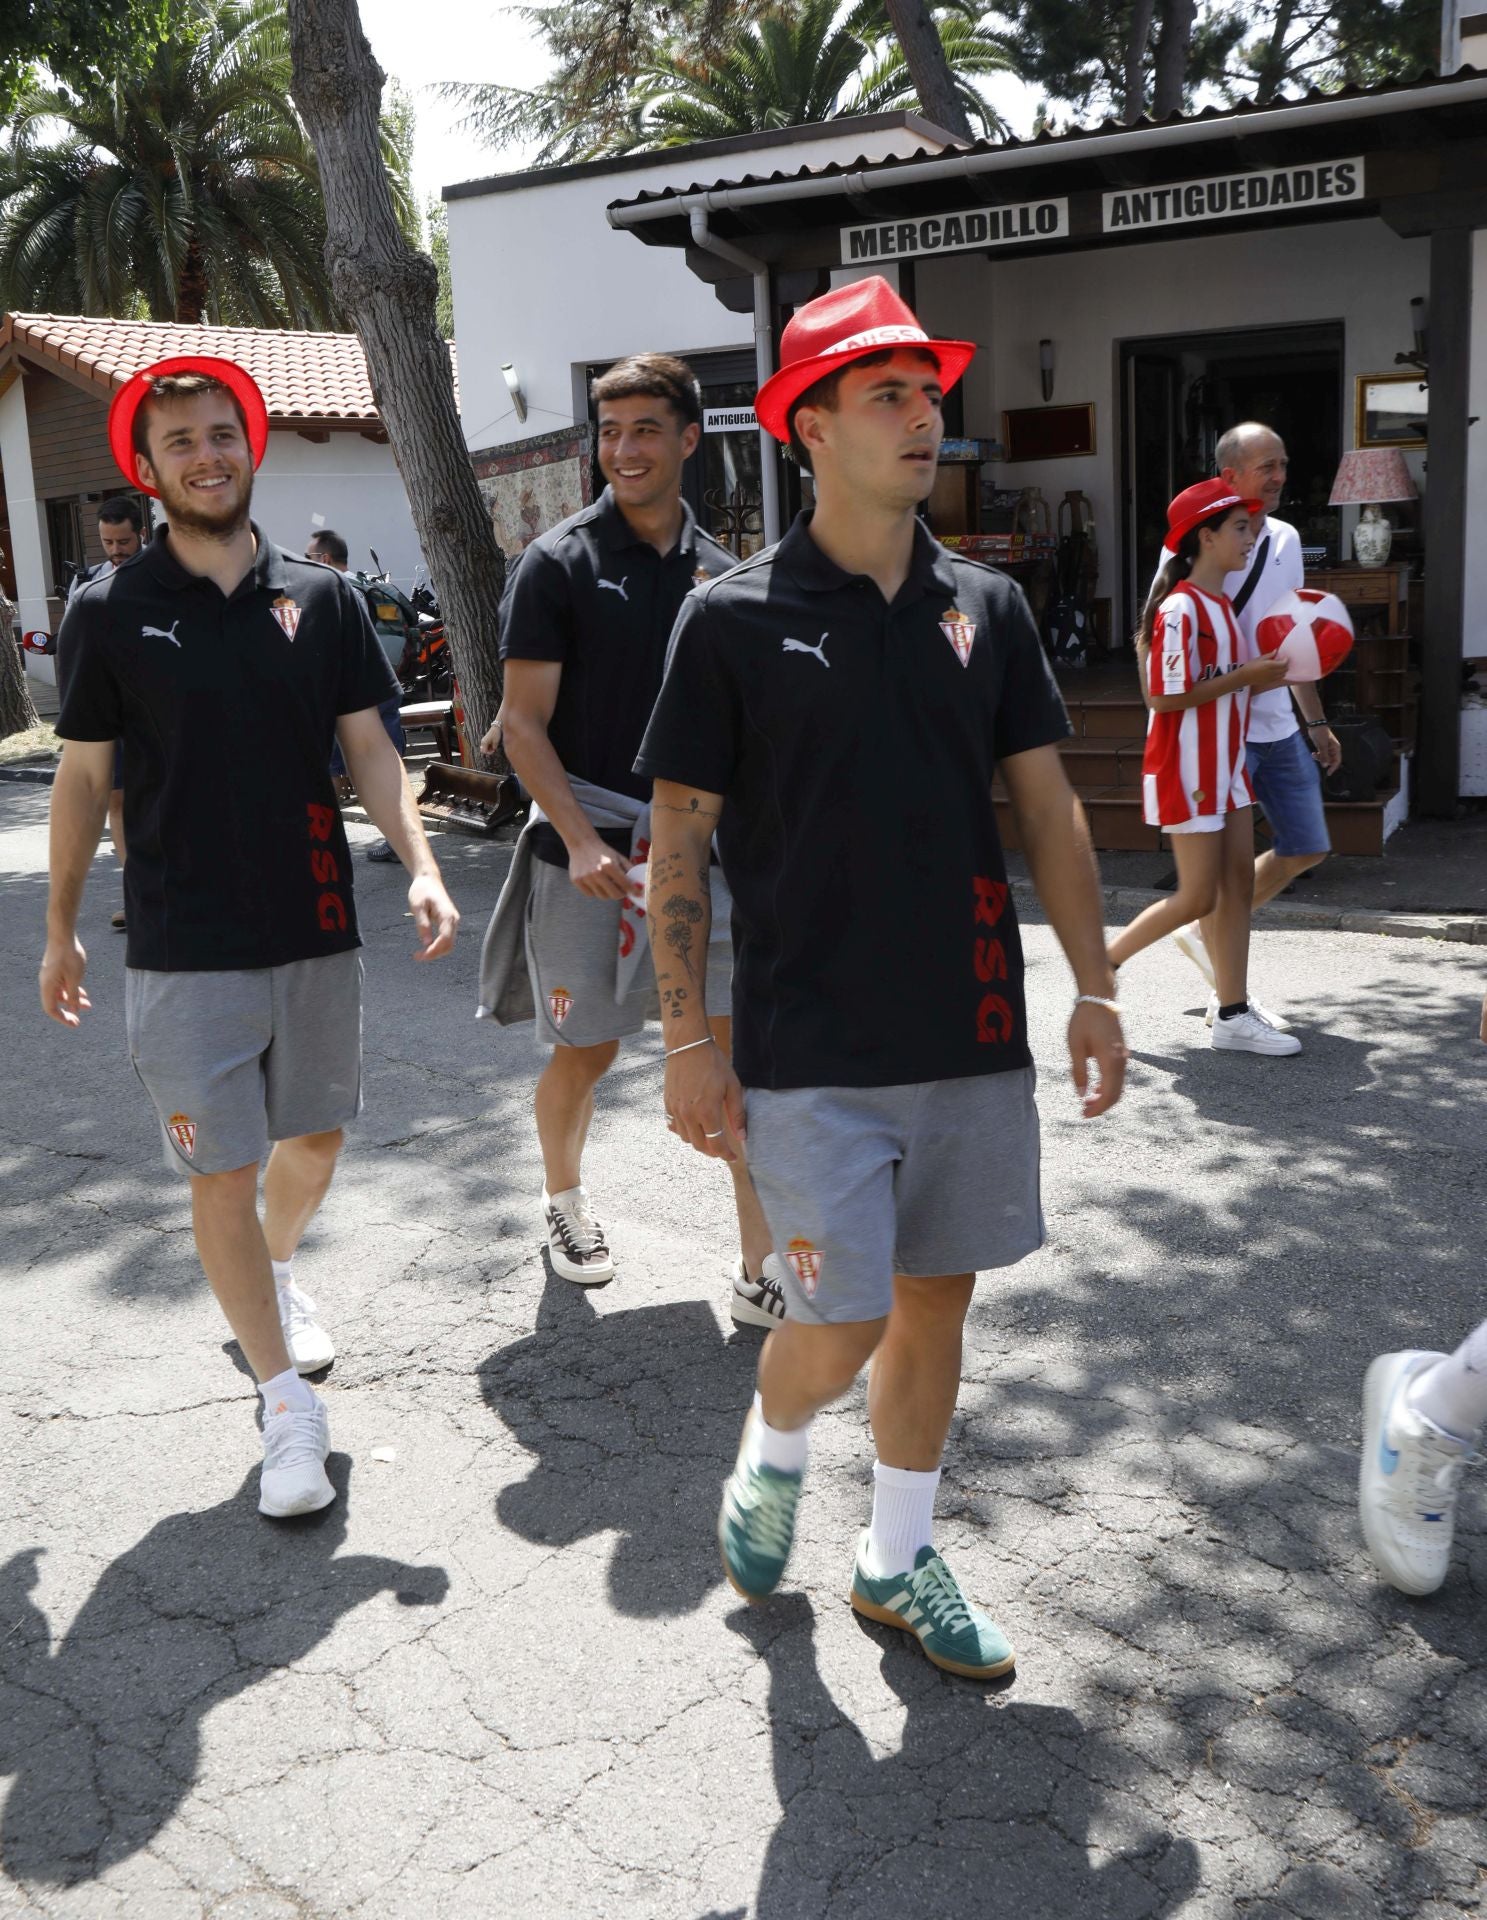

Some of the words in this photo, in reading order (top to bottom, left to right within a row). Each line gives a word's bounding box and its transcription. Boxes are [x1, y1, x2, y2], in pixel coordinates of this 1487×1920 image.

[1110, 162, 1357, 227] ANTIGUEDADES
[849, 203, 1059, 259] MERCADILLO
[707, 412, 759, 426] ANTIGUEDA
[307, 803, 347, 932] RSG
[972, 875, 1014, 1043] RSG
